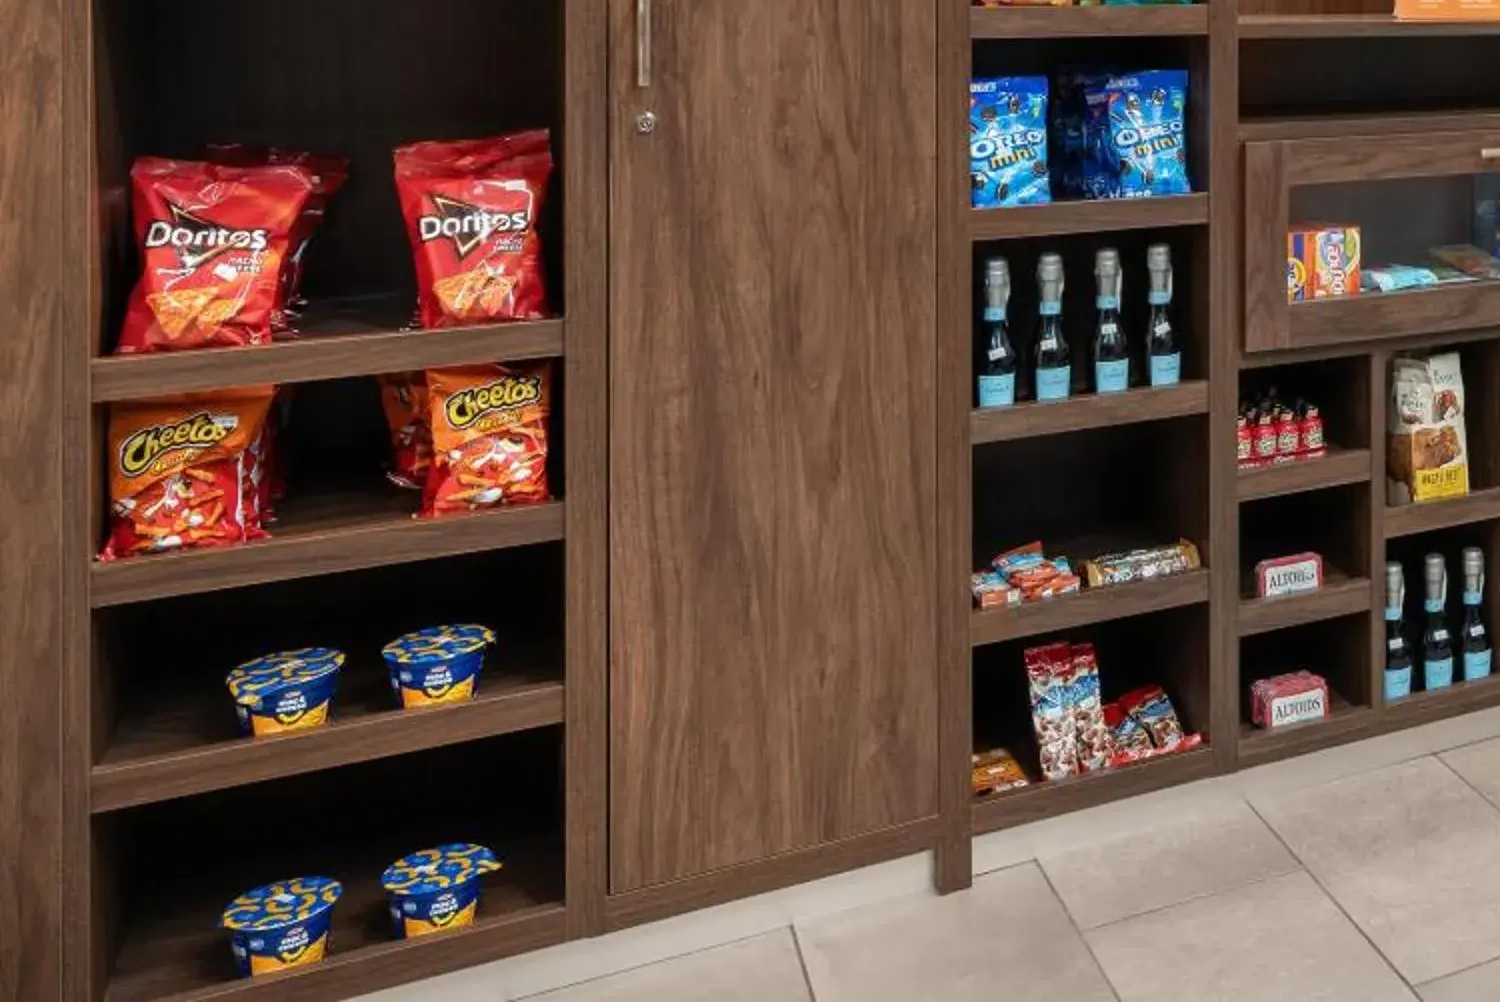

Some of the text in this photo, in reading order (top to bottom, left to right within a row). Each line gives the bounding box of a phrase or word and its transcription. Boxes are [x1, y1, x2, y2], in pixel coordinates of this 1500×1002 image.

[970, 129, 1043, 159] OREO
[146, 222, 267, 249] Doritos
[419, 211, 528, 240] Doritos
[448, 379, 538, 426] Cheetos
[122, 417, 229, 473] Cheetos
